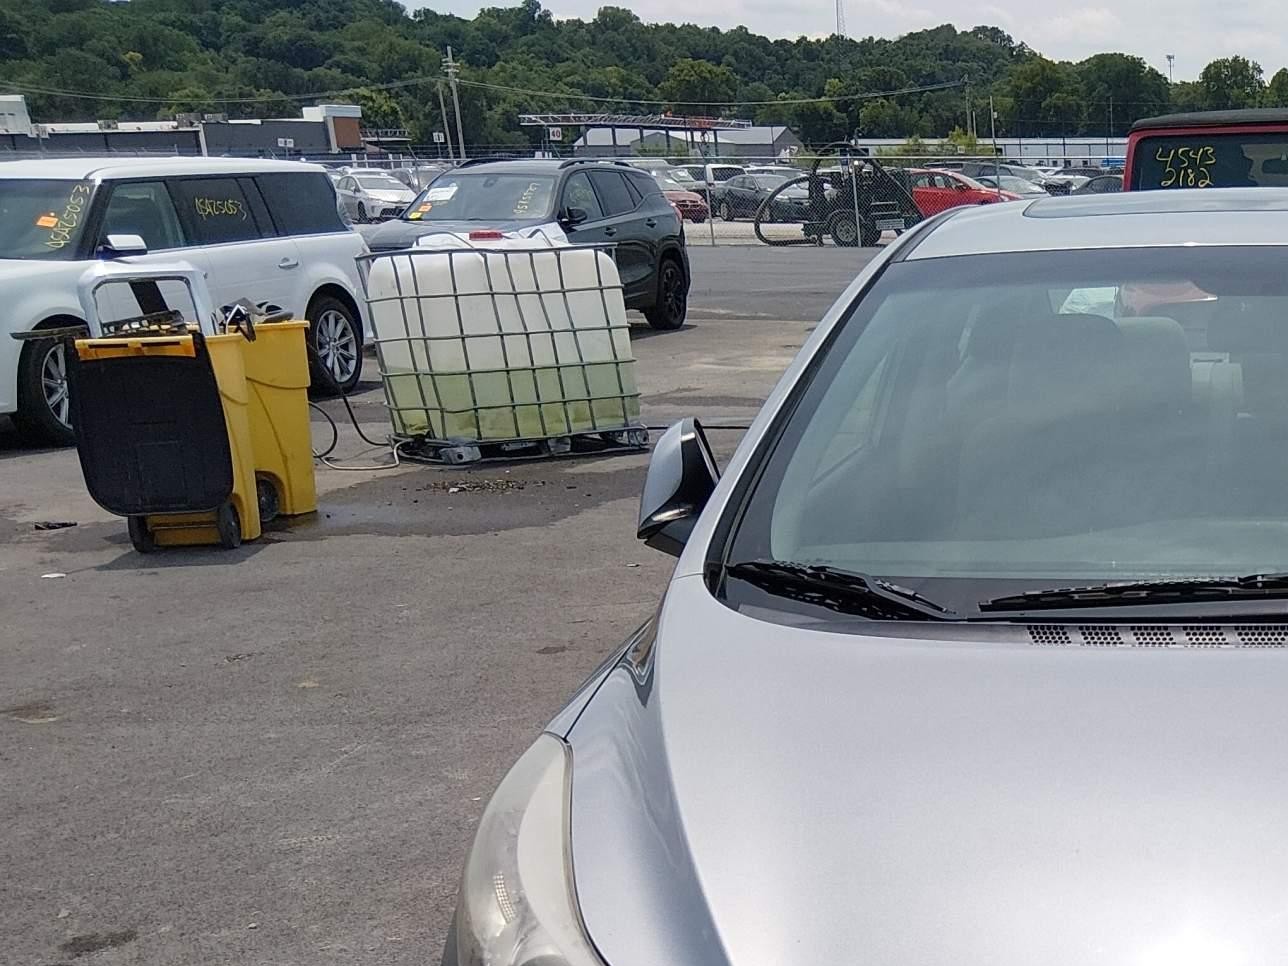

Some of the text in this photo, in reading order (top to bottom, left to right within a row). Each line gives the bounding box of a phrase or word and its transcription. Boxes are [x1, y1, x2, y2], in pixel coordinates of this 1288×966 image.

[551, 129, 561, 138] 40
[1156, 146, 1216, 169] 4543
[1160, 167, 1214, 187] 2182
